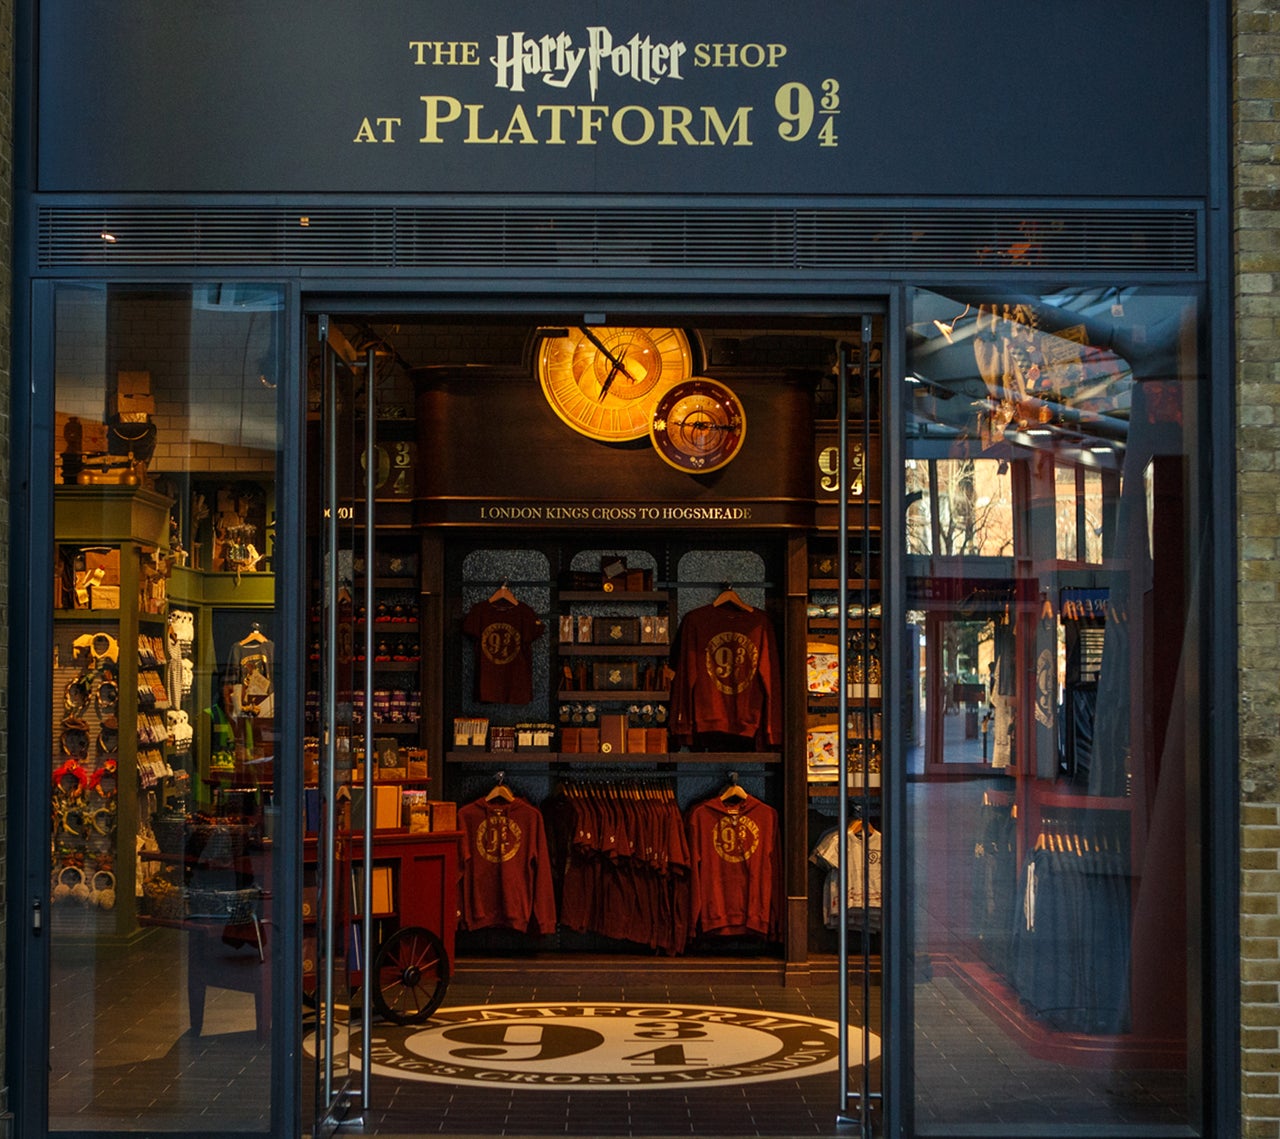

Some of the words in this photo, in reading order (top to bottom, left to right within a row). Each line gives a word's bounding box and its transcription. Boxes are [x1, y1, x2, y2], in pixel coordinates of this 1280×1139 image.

[409, 41, 480, 66] THE
[489, 31, 587, 93] Harry
[586, 26, 687, 102] Potter
[694, 43, 787, 68] SHOP
[353, 116, 402, 143] AT
[419, 95, 754, 146] PLATFORM
[479, 507, 543, 520] LONDON
[545, 507, 590, 519] KINGS
[591, 507, 638, 520] CROSS
[638, 508, 661, 520] TO
[662, 507, 753, 520] HOGSMEADE
[474, 1070, 641, 1084] CROSS
[677, 1047, 831, 1081] LONDON
